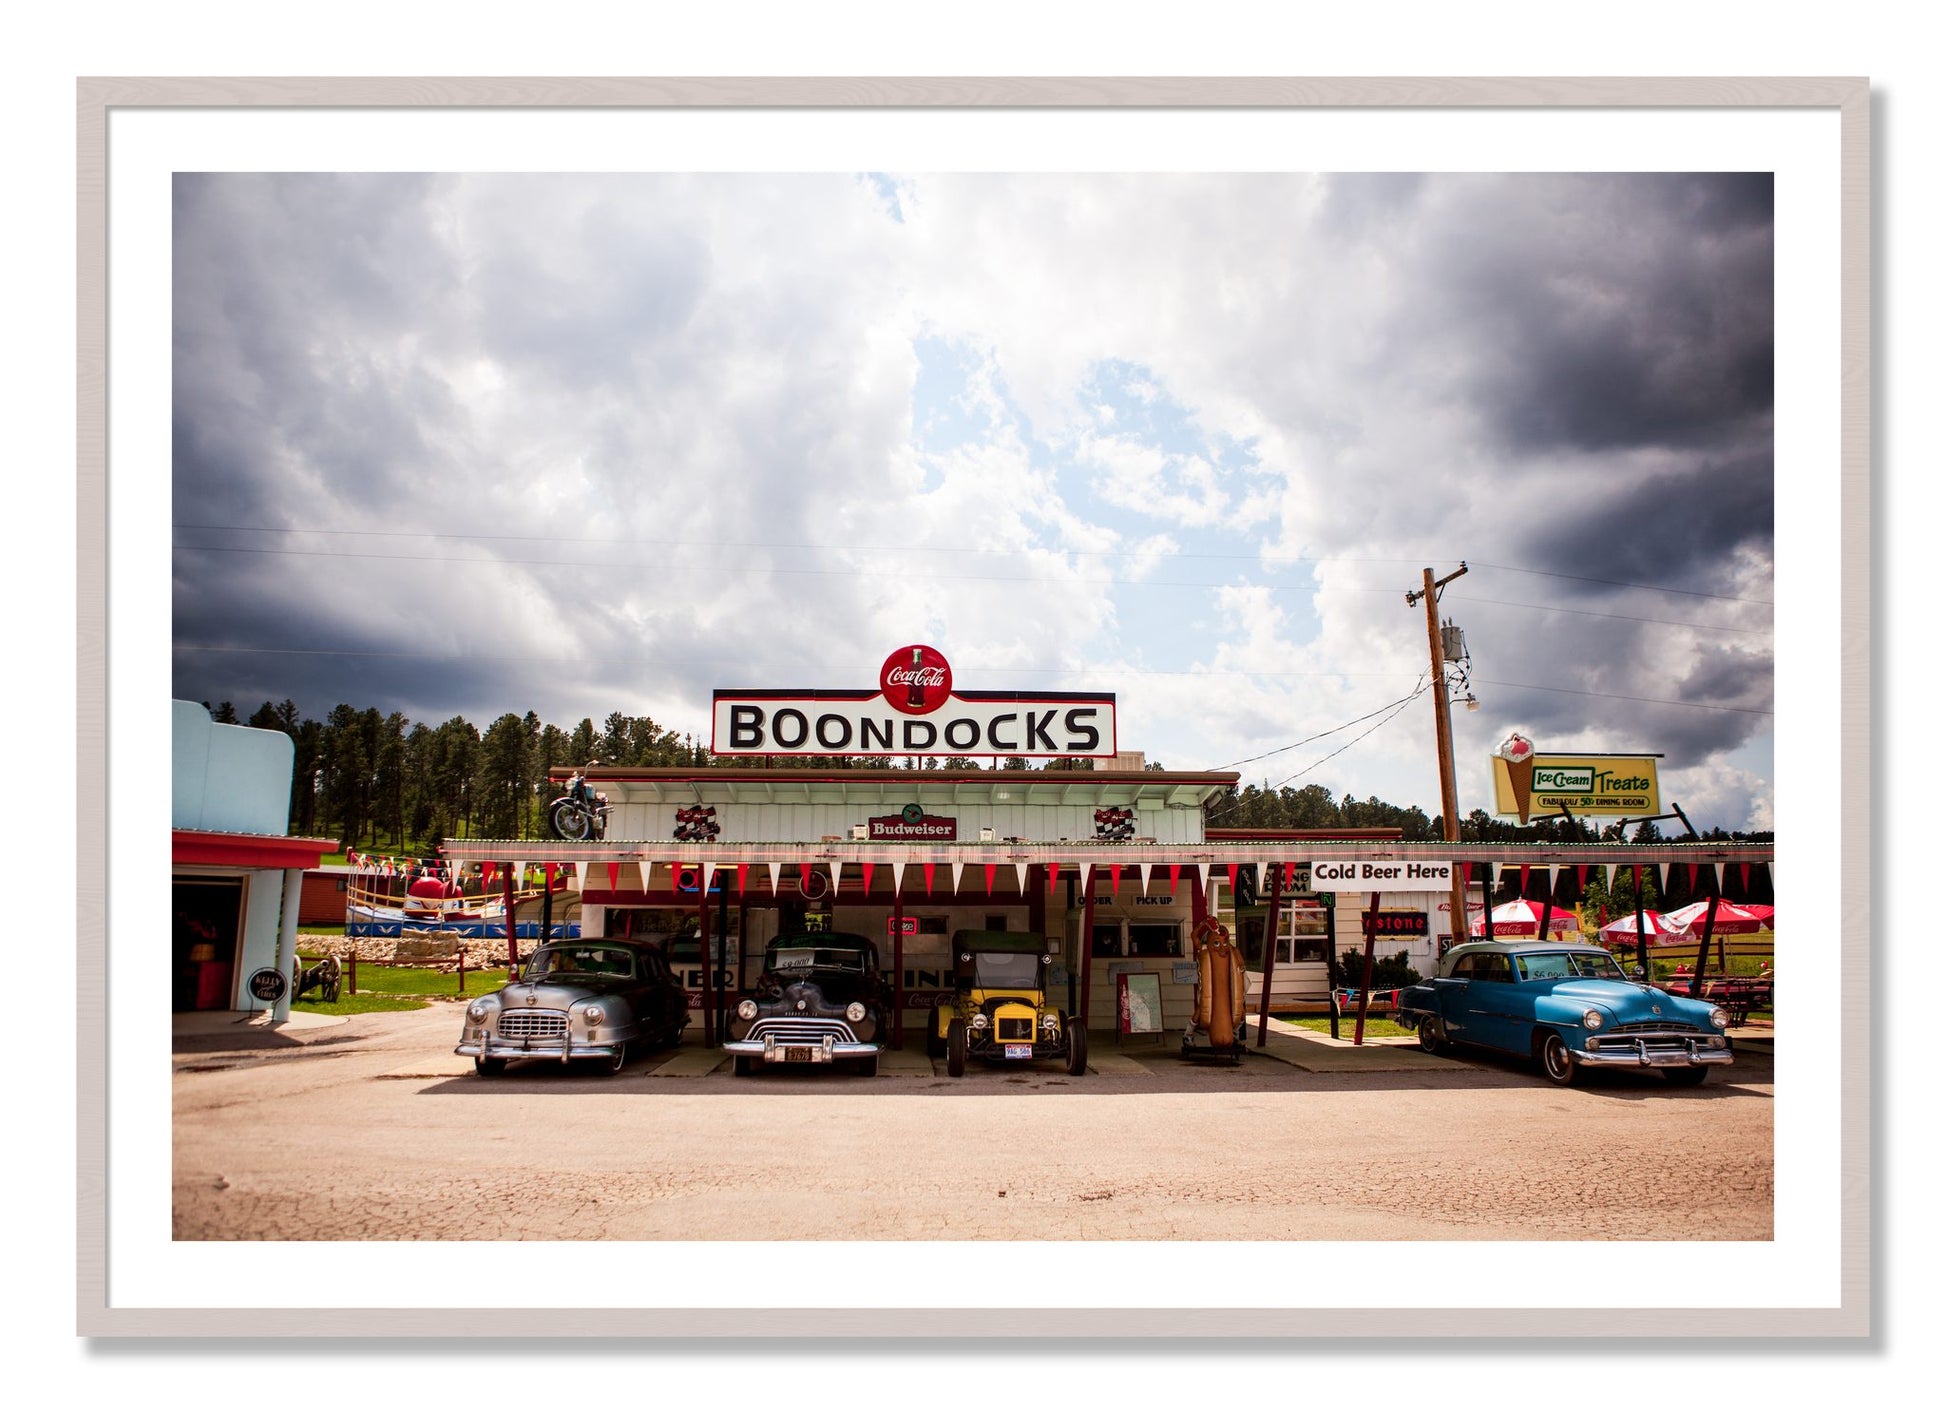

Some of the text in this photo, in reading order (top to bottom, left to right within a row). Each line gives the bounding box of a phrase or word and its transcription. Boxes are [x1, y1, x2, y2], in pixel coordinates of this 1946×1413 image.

[887, 666, 947, 687] Coca-Cola
[729, 704, 1101, 751] BOONDOCKS
[1536, 770, 1650, 793] Ice Cream Treats
[1596, 798, 1620, 806] DINING
[1623, 798, 1646, 806] ROOM
[873, 823, 952, 835] Budweiser
[1315, 864, 1449, 880] Cold Beer Here
[1078, 897, 1112, 905] ODER
[1136, 897, 1173, 905] PICK UP
